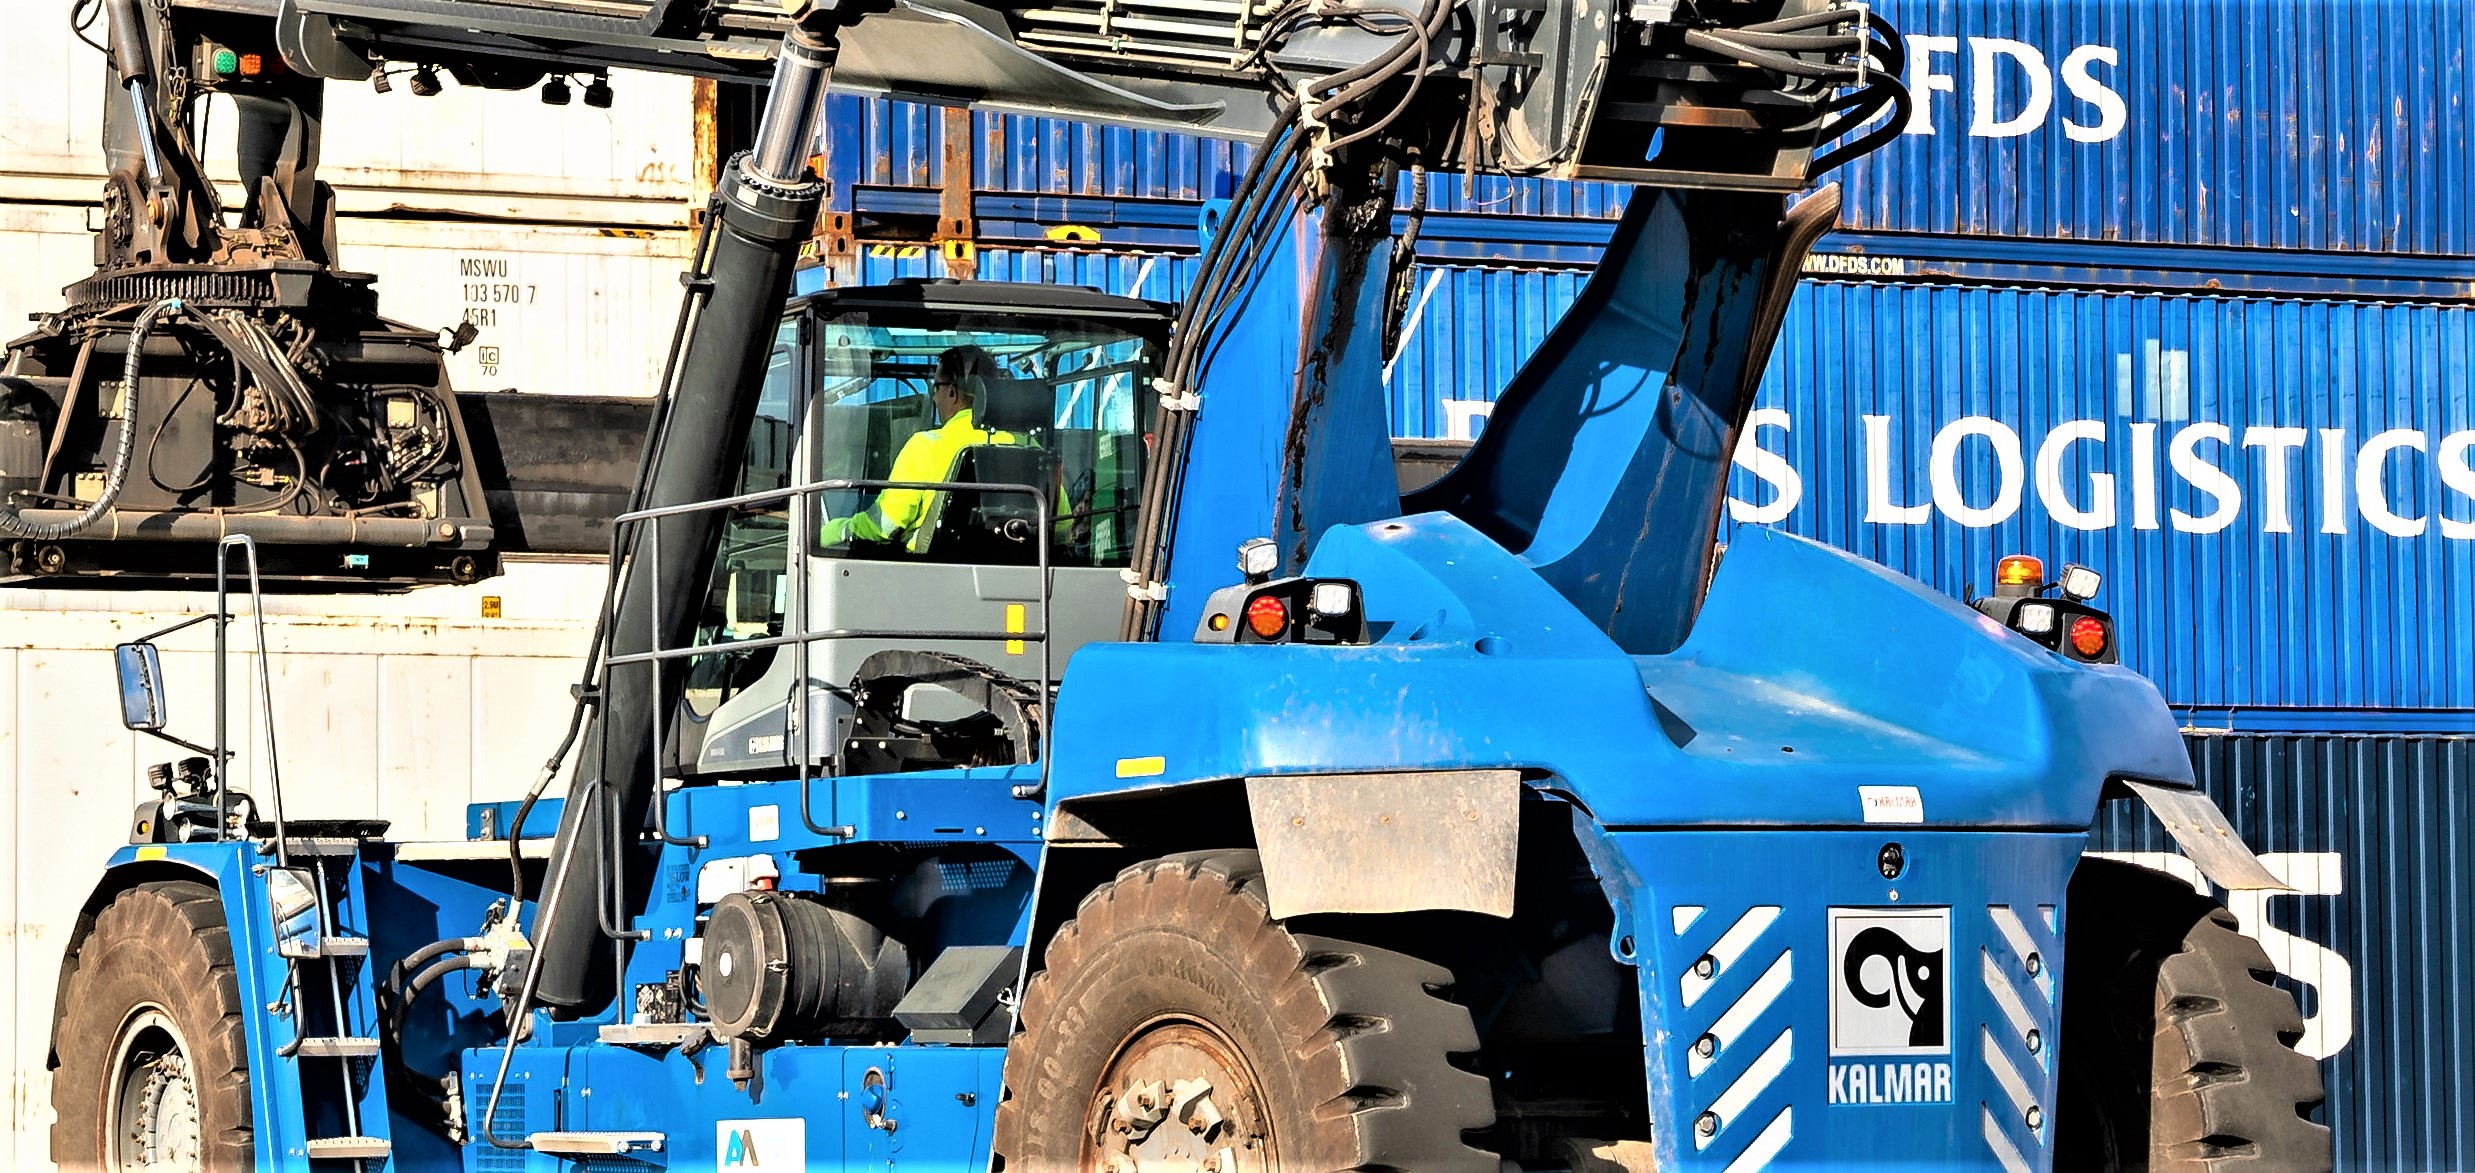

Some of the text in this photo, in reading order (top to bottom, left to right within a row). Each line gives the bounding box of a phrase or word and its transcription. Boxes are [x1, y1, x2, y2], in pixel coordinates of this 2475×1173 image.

[1821, 33, 2127, 143] FDS
[460, 258, 507, 278] MSWU
[1801, 253, 1905, 276] WW.DFDS.COM
[463, 283, 537, 305] 103 570 7
[462, 307, 497, 328] 45R1
[480, 365, 498, 377] 70
[1862, 413, 2475, 541] LOGISTICS
[1828, 1062, 1952, 1105] KALMAR
